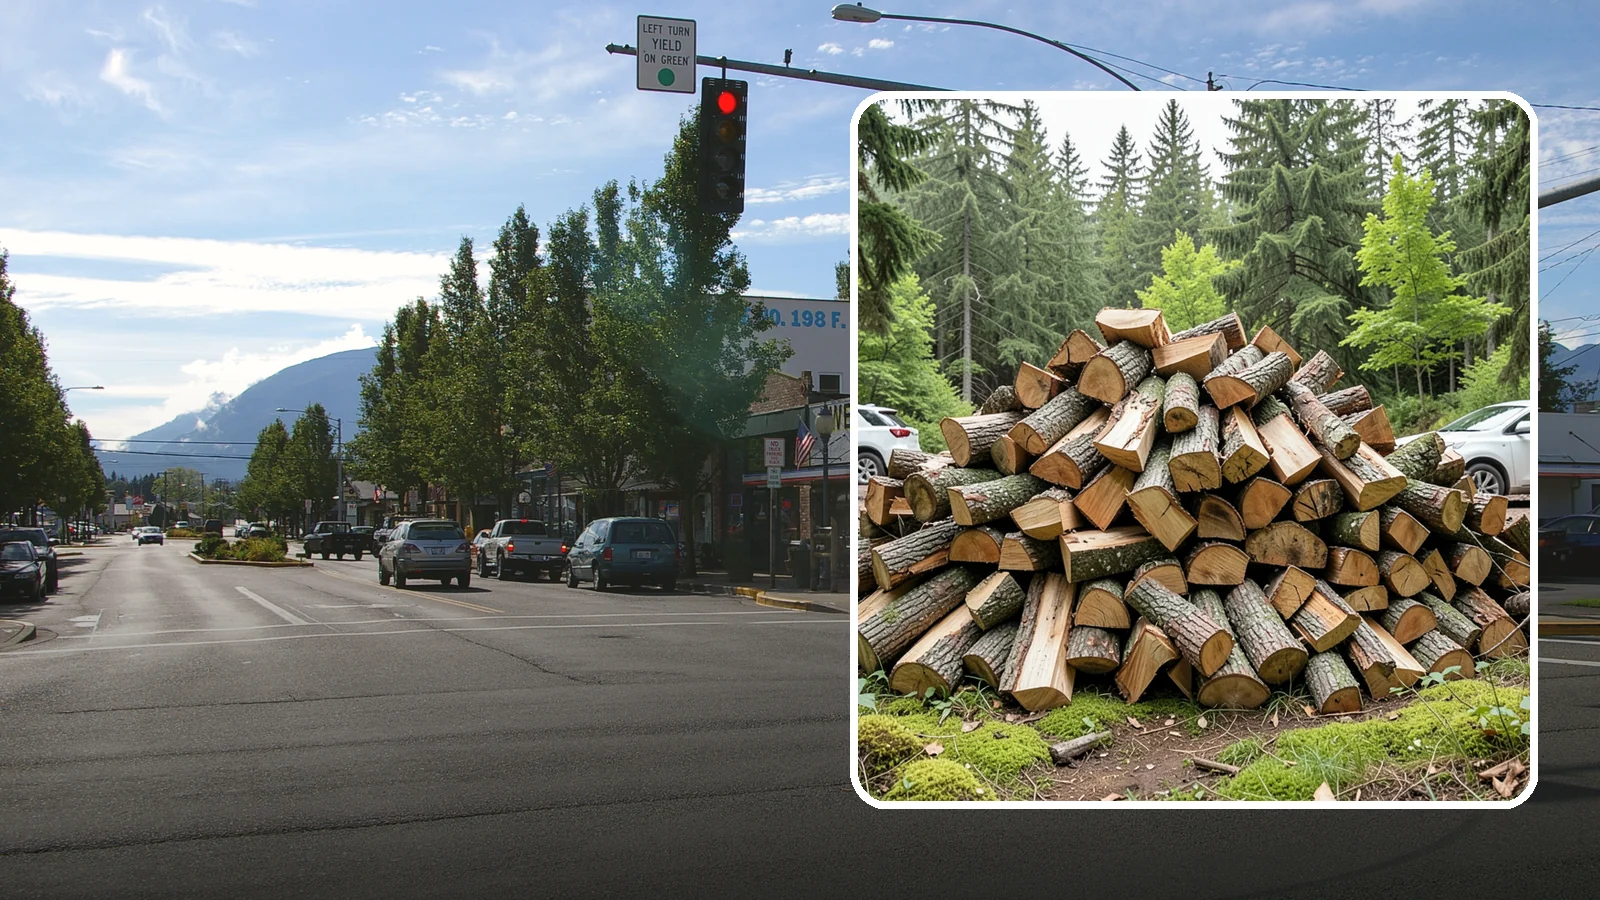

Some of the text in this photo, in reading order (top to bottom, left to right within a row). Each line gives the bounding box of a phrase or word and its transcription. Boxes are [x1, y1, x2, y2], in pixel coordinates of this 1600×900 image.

[642, 24, 690, 36] LEFT TURN
[652, 38, 682, 52] YIELD
[644, 53, 688, 66] ON GREEN
[791, 310, 826, 328] 198
[832, 312, 846, 328] F.
